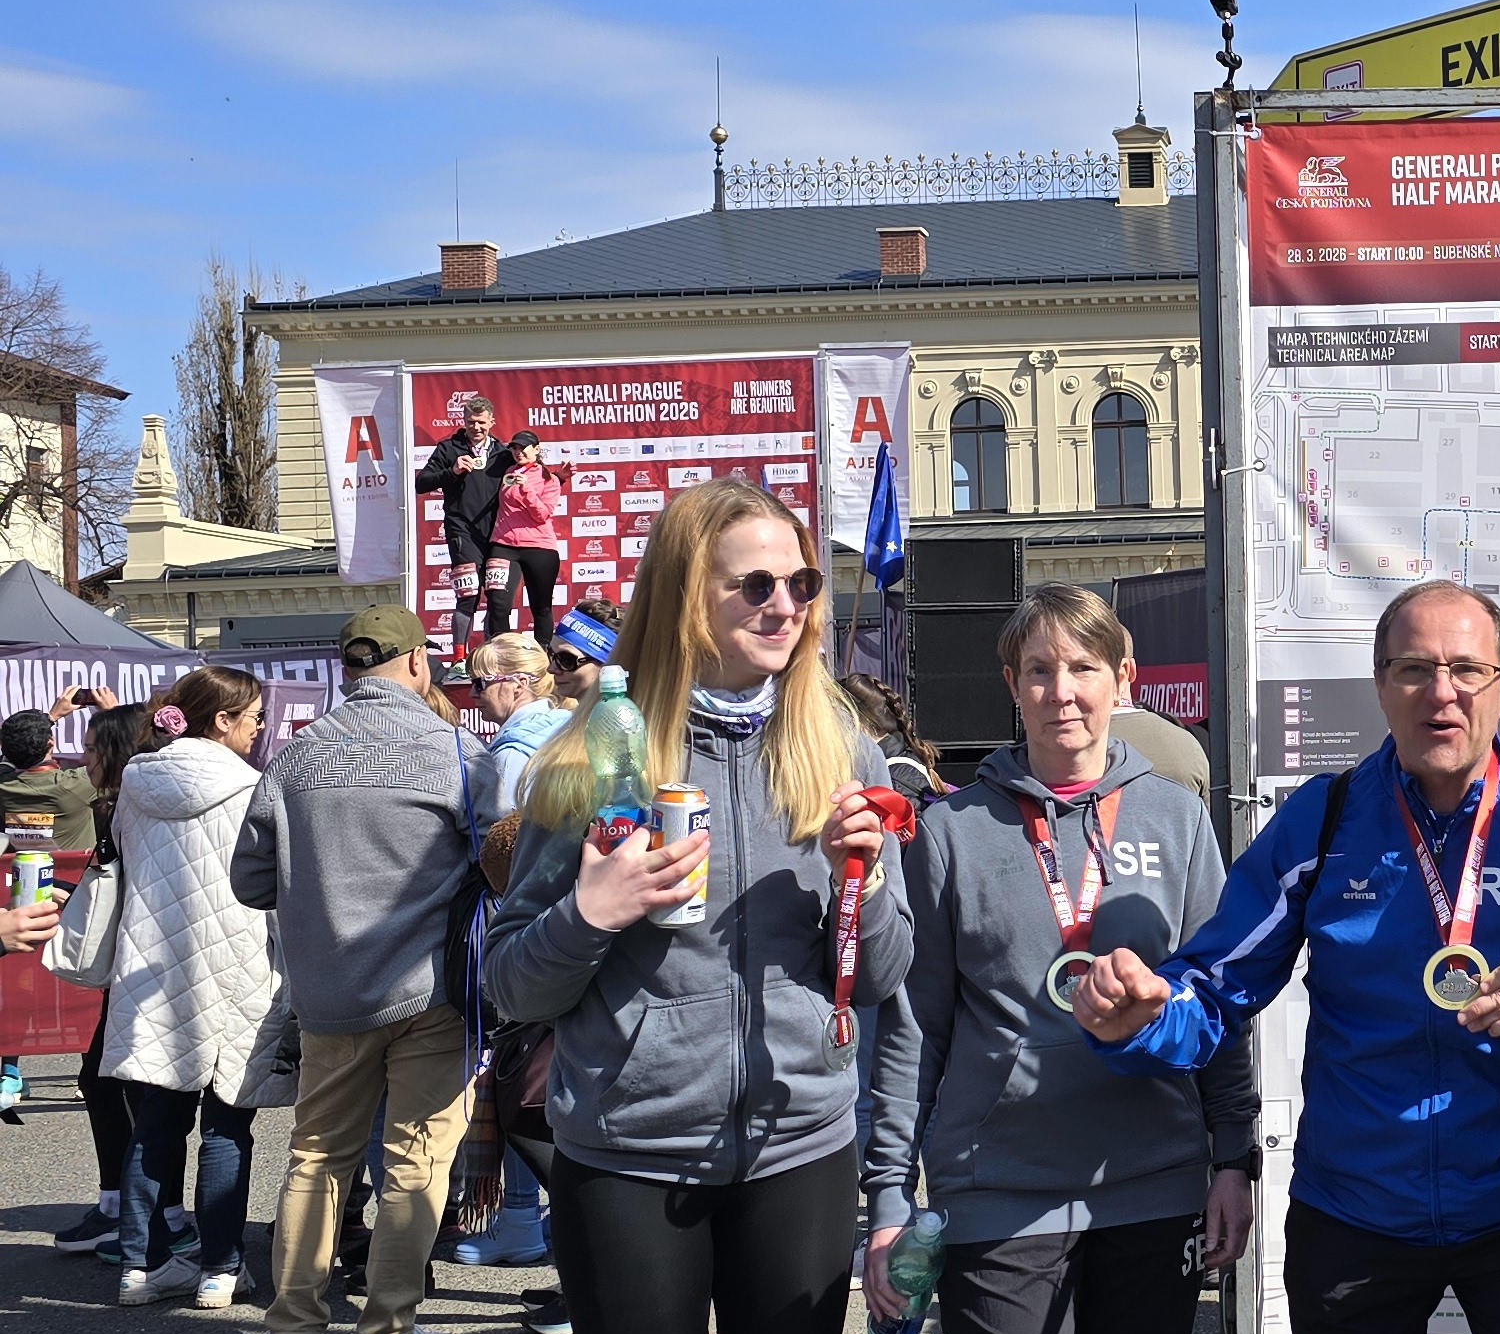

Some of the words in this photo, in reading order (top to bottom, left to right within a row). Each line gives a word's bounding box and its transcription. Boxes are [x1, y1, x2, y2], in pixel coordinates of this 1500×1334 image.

[1391, 153, 1486, 180] GENERALI
[1298, 187, 1348, 197] GENERALI
[1391, 181, 1440, 206] HALF
[1275, 196, 1309, 209] ČESKÁ
[1287, 249, 1305, 263] 28.
[1306, 249, 1316, 263] 3.
[1318, 247, 1347, 262] 2026
[1357, 246, 1393, 261] START
[1394, 246, 1425, 261] 10:00
[1433, 241, 1492, 260] BUBENSKÉ
[1277, 331, 1309, 346] MAPA
[1310, 328, 1387, 346] TECHNICKÉHO
[1389, 327, 1430, 343] ZÁZEMÍ
[1277, 348, 1338, 363] TECHNICAL
[1339, 347, 1369, 362] AREA
[1370, 346, 1396, 361] MAP
[542, 383, 618, 405] GENERALI
[621, 380, 683, 402] PRAGUE
[733, 380, 749, 398] ALL
[750, 379, 792, 397] RUNNERS
[528, 406, 567, 427] HALF
[570, 403, 657, 426] MARATHON
[659, 401, 699, 422] 2026
[730, 398, 749, 415] ARE
[750, 396, 797, 414] BEAUTIFUL
[849, 396, 894, 443] A
[345, 415, 384, 463] A
[772, 466, 799, 477] Hilton
[845, 455, 899, 470] AJEO
[342, 474, 388, 490] AJETO
[1491, 486, 1500, 495] 11
[1487, 554, 1498, 563] 13
[453, 576, 474, 590] 9713
[598, 824, 633, 836] TONI
[1112, 840, 1162, 879] SE
[839, 877, 861, 914] BEAUTIFUL
[1342, 890, 1377, 900] erima
[1181, 1233, 1207, 1277] SE
